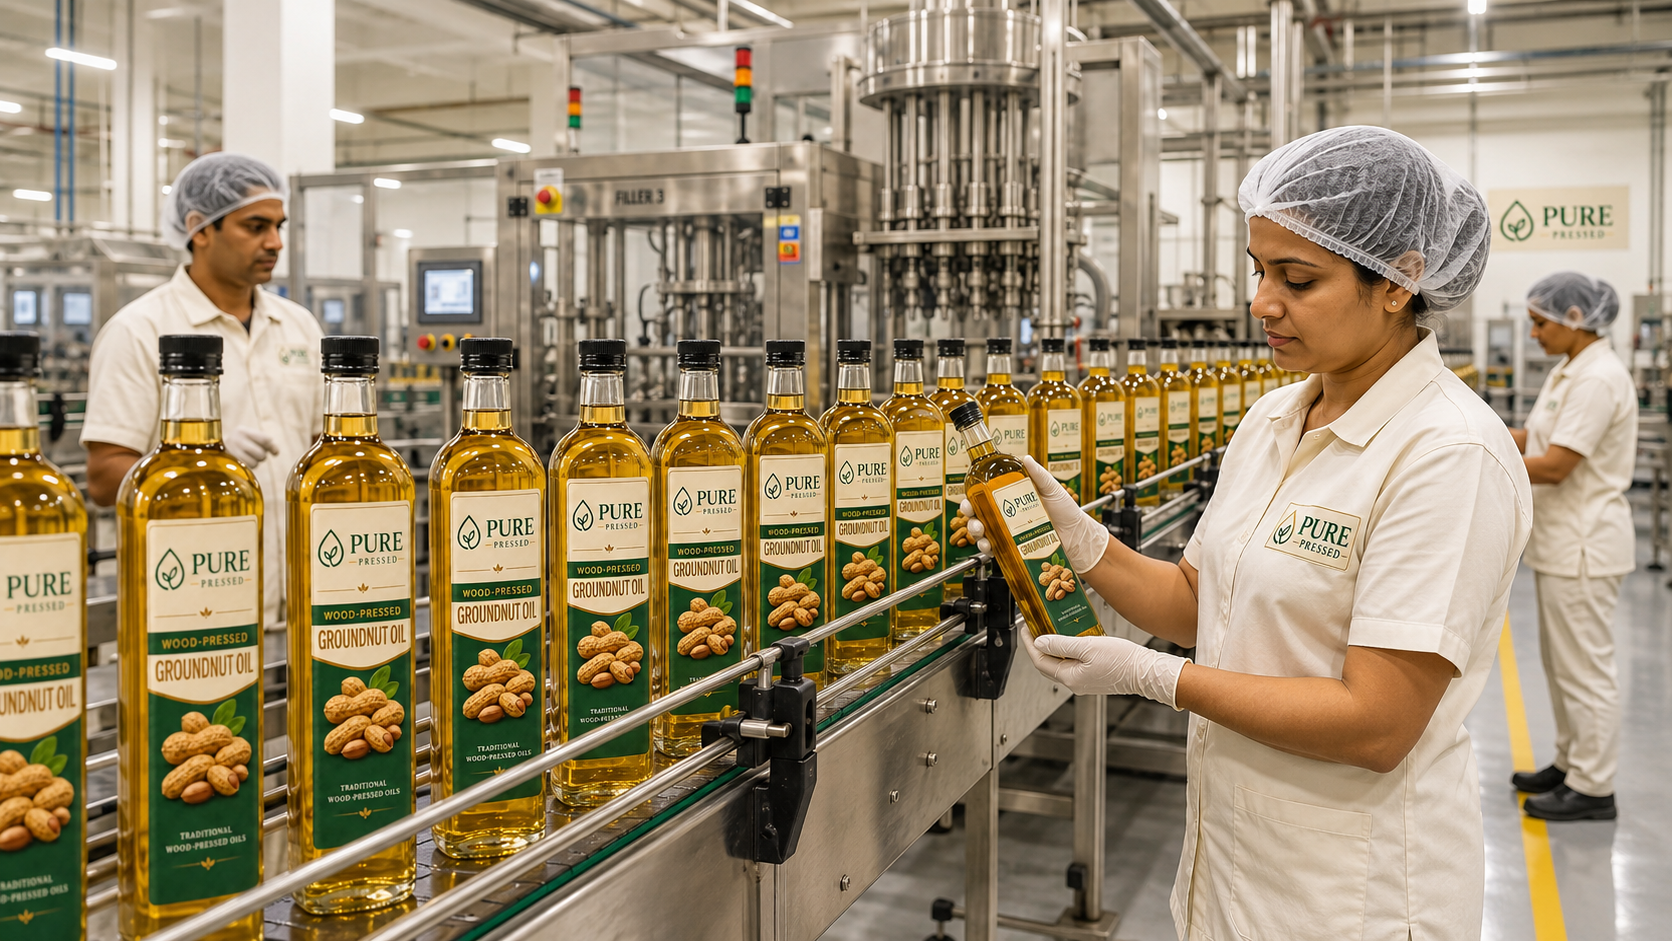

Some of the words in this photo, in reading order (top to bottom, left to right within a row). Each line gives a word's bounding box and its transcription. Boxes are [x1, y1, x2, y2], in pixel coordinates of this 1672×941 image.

[615, 188, 650, 206] FILLER
[655, 189, 664, 203] 3
[1543, 204, 1614, 227] PURE
[1553, 230, 1605, 239] PRESSED
[1004, 429, 1025, 439] PURE
[915, 447, 940, 460] PURE
[858, 462, 887, 476] PURE
[786, 475, 821, 491] PURE
[696, 488, 737, 506] PURE
[1014, 491, 1038, 508] PURE
[598, 502, 643, 521] PURE
[486, 517, 535, 538] PURE
[605, 522, 638, 530] PRESSED
[1298, 515, 1352, 548] PURE
[350, 531, 403, 554] PURE
[493, 539, 529, 549] PRESSED
[764, 540, 810, 556] GROUNDNUT
[811, 539, 823, 553] OIL
[1299, 539, 1341, 559] PRESSED
[192, 550, 250, 575] PURE
[358, 556, 398, 566] PRESSED
[577, 563, 641, 575] WOOD-PRESSED
[673, 560, 725, 577] GROUNDNUT
[726, 558, 739, 574] OIL
[6, 571, 73, 599] PURE
[201, 576, 244, 588] PRESSED
[572, 579, 631, 599] GROUNDNUT
[631, 578, 645, 595] OIL
[462, 584, 533, 598] WOOD-PRESSED
[16, 600, 65, 614] PRESSED
[323, 606, 401, 620] WOOD-PRESSED
[457, 602, 521, 625] GROUNDNUT
[522, 601, 537, 620] OIL
[161, 632, 248, 650] WOOD-PRESSED
[318, 625, 389, 650] GROUNDNUT
[390, 624, 407, 644] OIL
[155, 654, 234, 682] GROUNDNUT
[236, 651, 254, 675] OIL
[57, 684, 77, 709] OIL
[477, 742, 520, 752] TRADITIONAL
[340, 780, 387, 791] TRADITIONAL
[327, 790, 384, 803] WOOD-PRESSED
[385, 787, 401, 796] OILS
[180, 826, 233, 840] TRADITIONAL
[165, 837, 229, 853] WOOD-PRESSED
[229, 834, 247, 844] OILS
[49, 883, 69, 896] OILS
